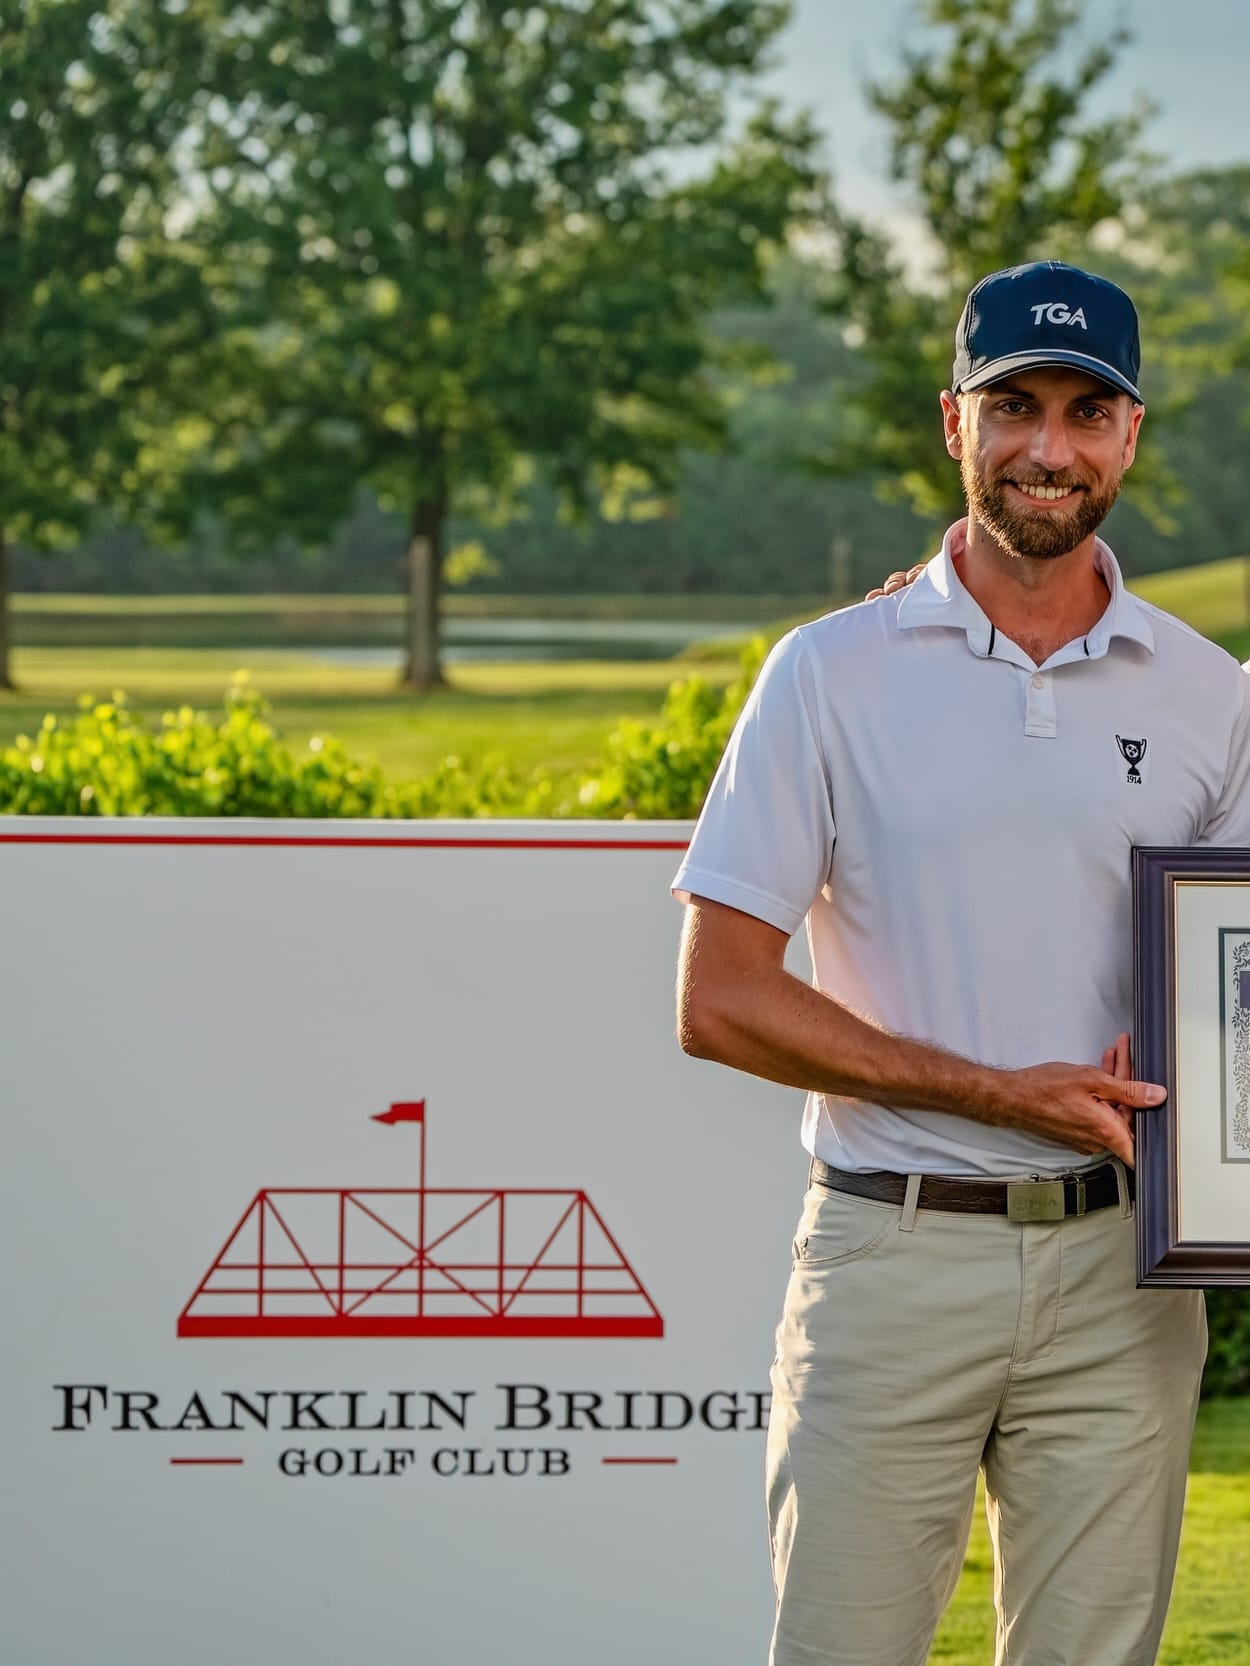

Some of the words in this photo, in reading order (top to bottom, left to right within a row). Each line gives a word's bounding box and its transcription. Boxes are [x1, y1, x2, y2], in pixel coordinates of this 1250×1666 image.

[1030, 302, 1088, 330] TGA
[52, 1384, 476, 1431] FRANKLIN
[278, 1448, 415, 1477] GOLF
[431, 1448, 571, 1477] CLUB
